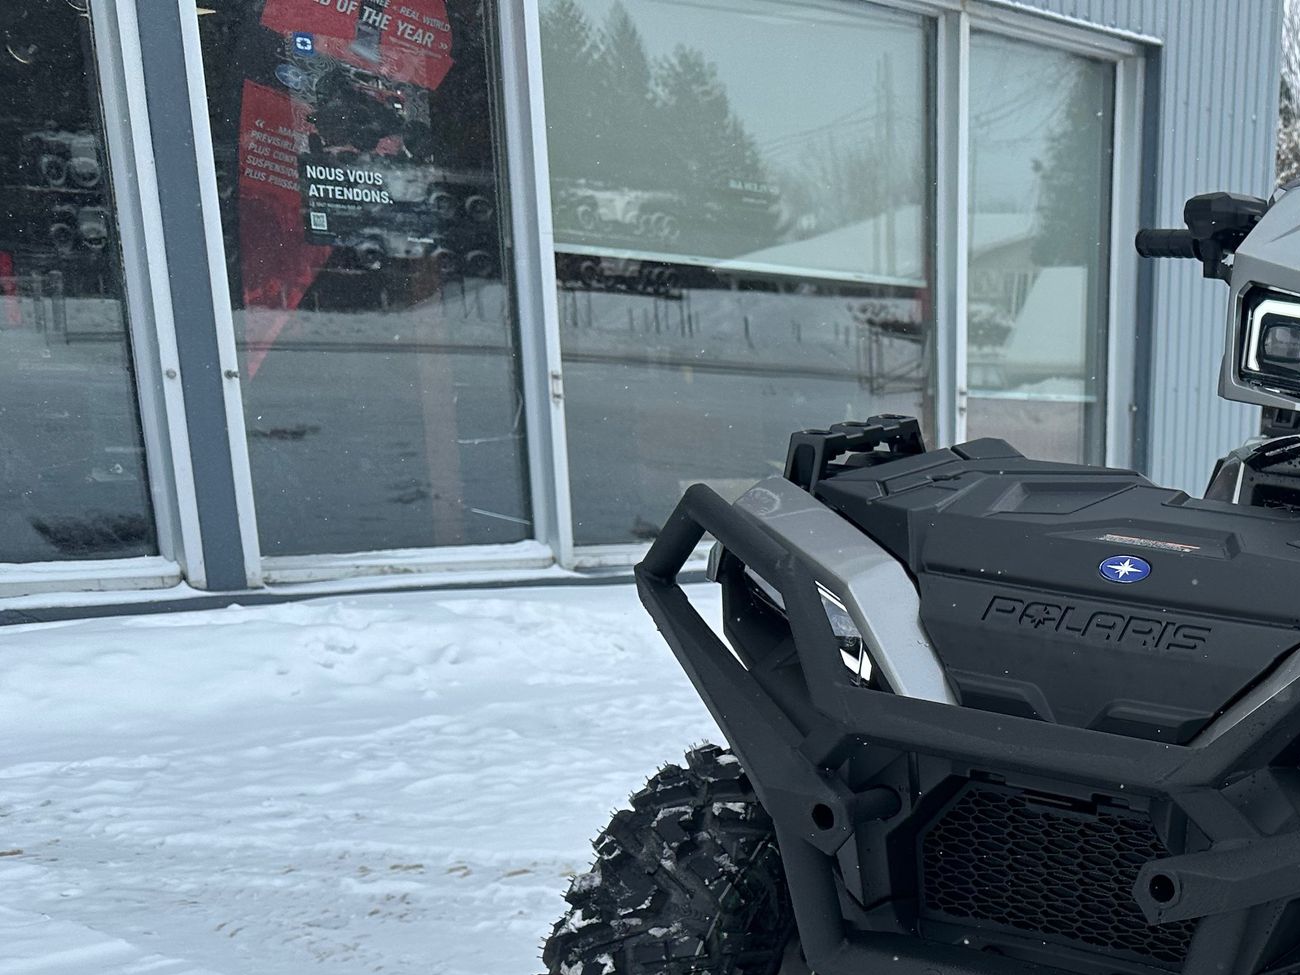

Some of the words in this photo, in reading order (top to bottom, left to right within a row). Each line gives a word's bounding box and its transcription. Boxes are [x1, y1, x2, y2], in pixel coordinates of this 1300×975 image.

[336, 0, 358, 15] OF
[362, 6, 392, 30] THE
[397, 20, 434, 48] YEAR
[306, 165, 345, 181] NOUS
[346, 169, 383, 185] VOUS
[308, 184, 394, 204] ATTENDONS.
[981, 595, 1212, 650] POLARIS
